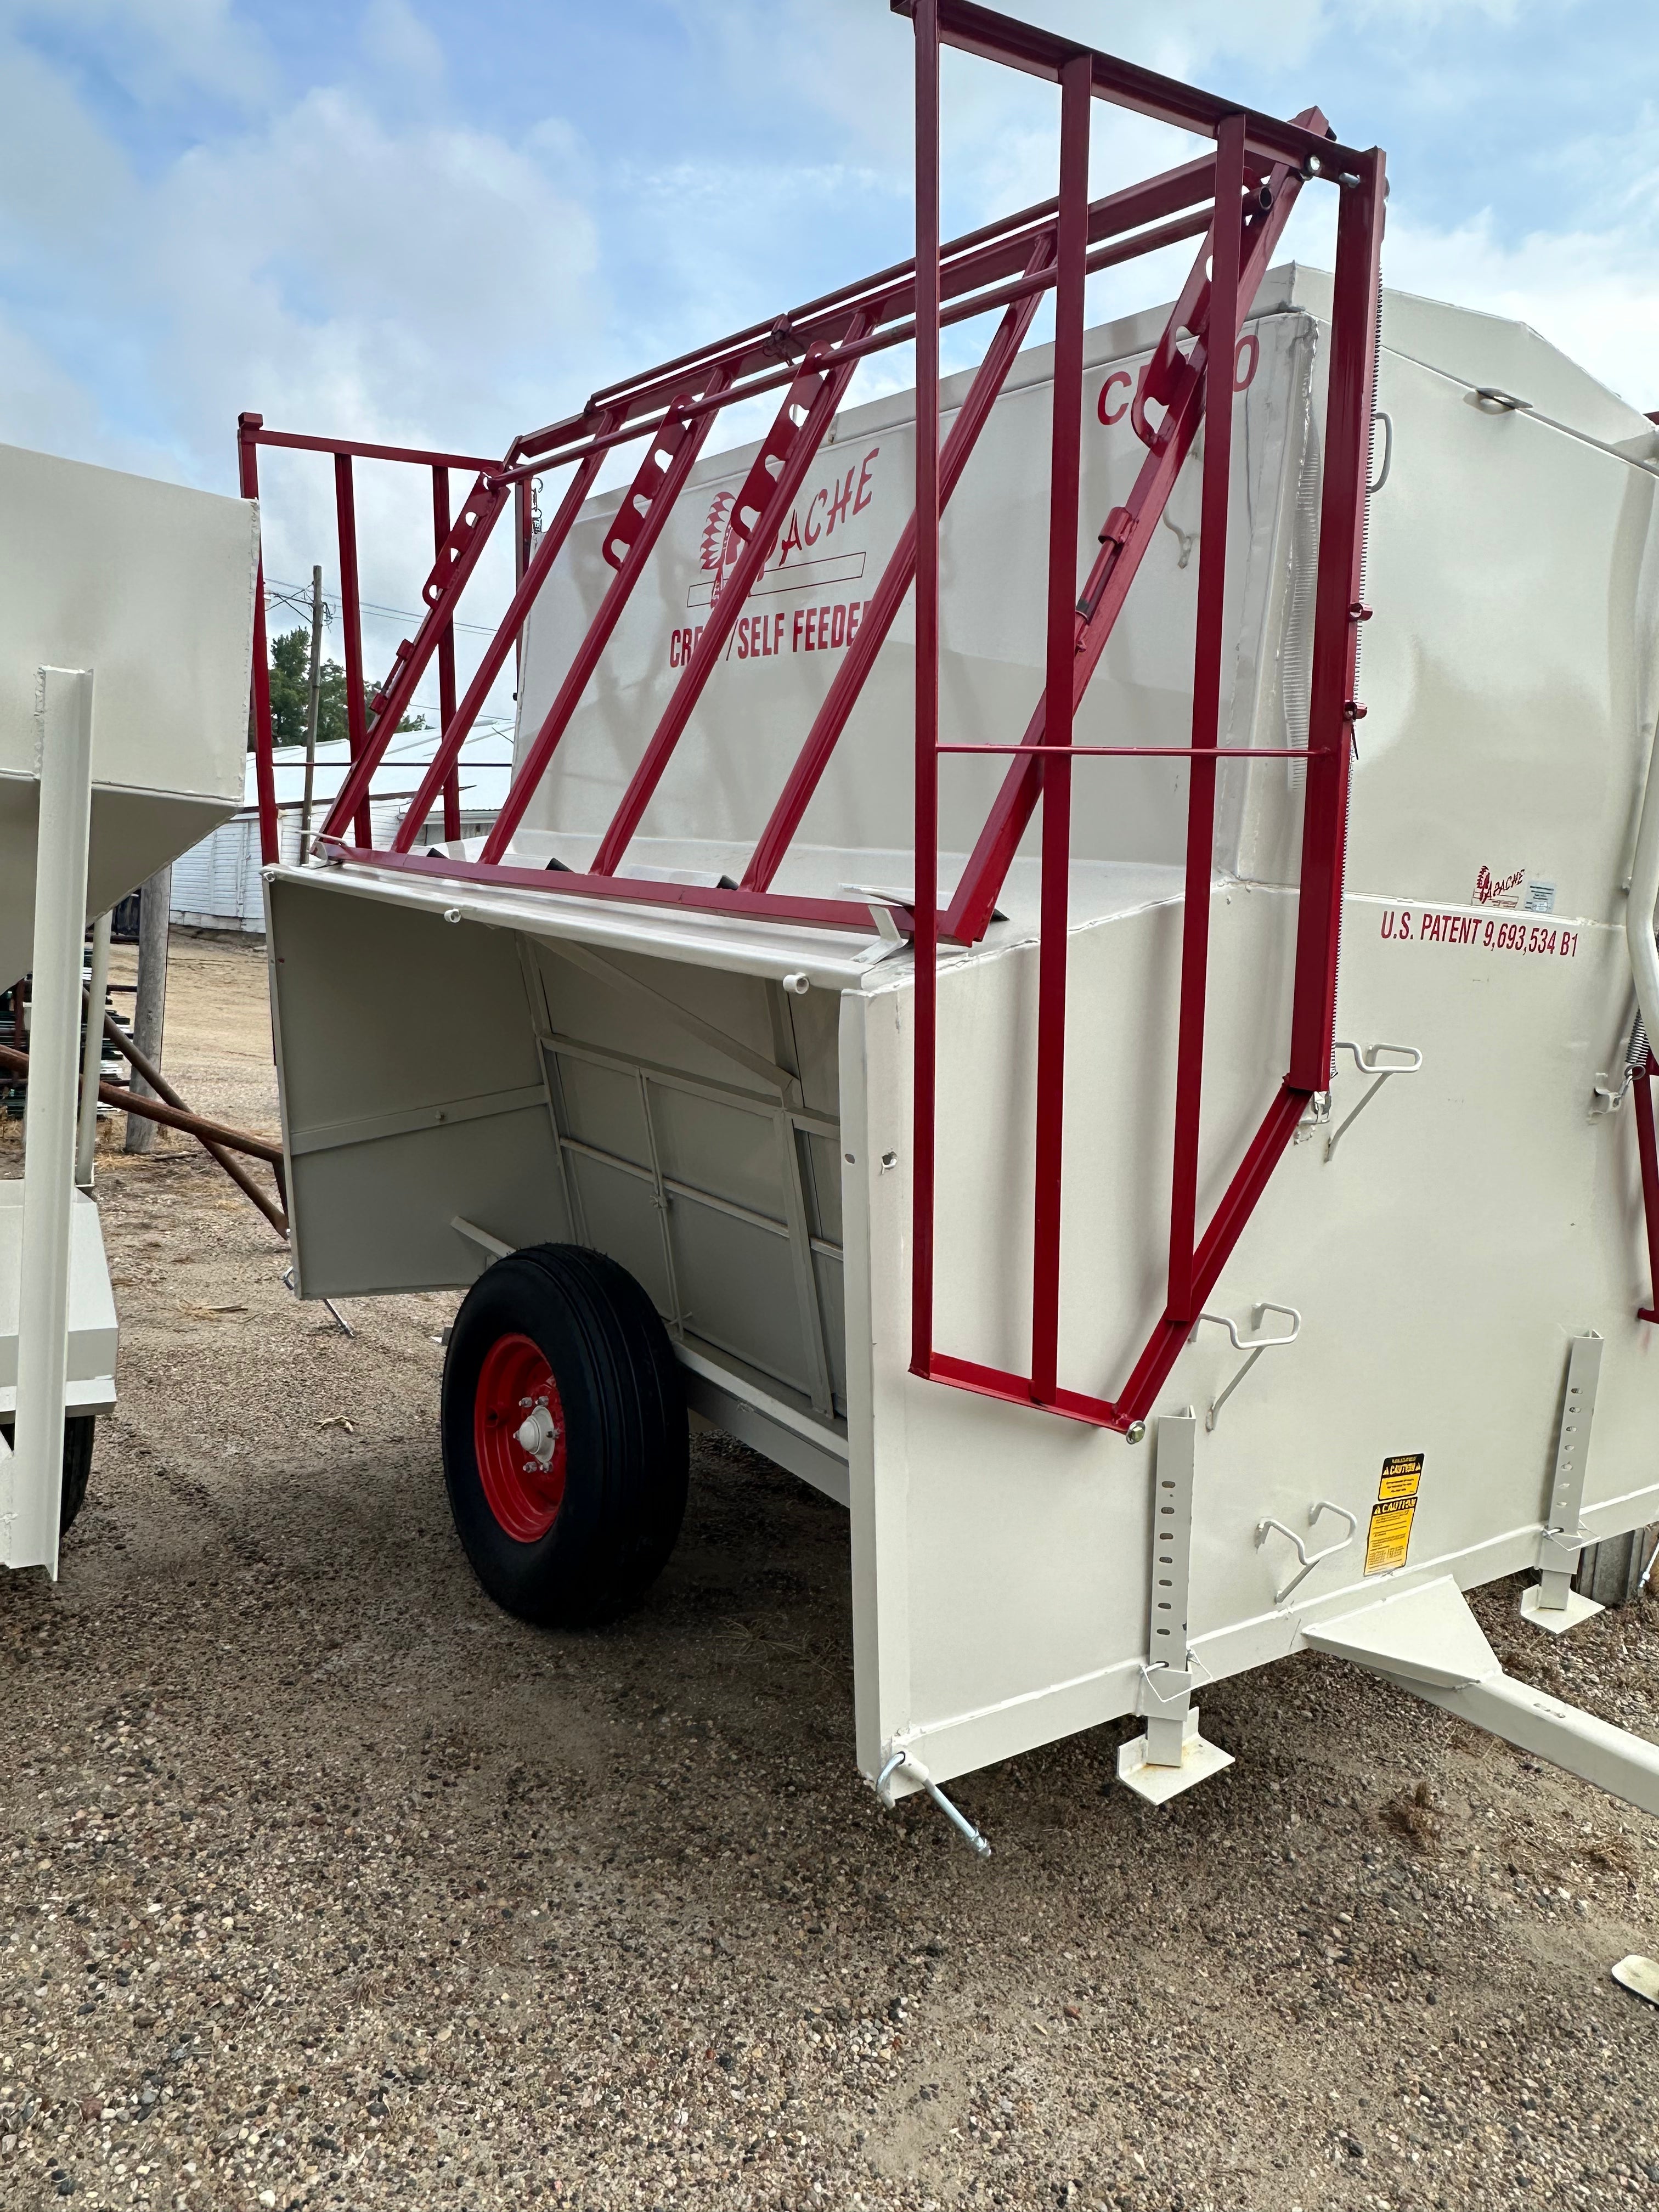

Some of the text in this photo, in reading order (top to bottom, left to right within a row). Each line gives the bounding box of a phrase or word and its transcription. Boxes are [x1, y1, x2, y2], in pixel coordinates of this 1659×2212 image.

[1482, 869, 1525, 904] APACHE
[1381, 911, 1579, 957] U.S. PATENT 9,693,534 B1
[1382, 1498, 1416, 1513] CAUTION
